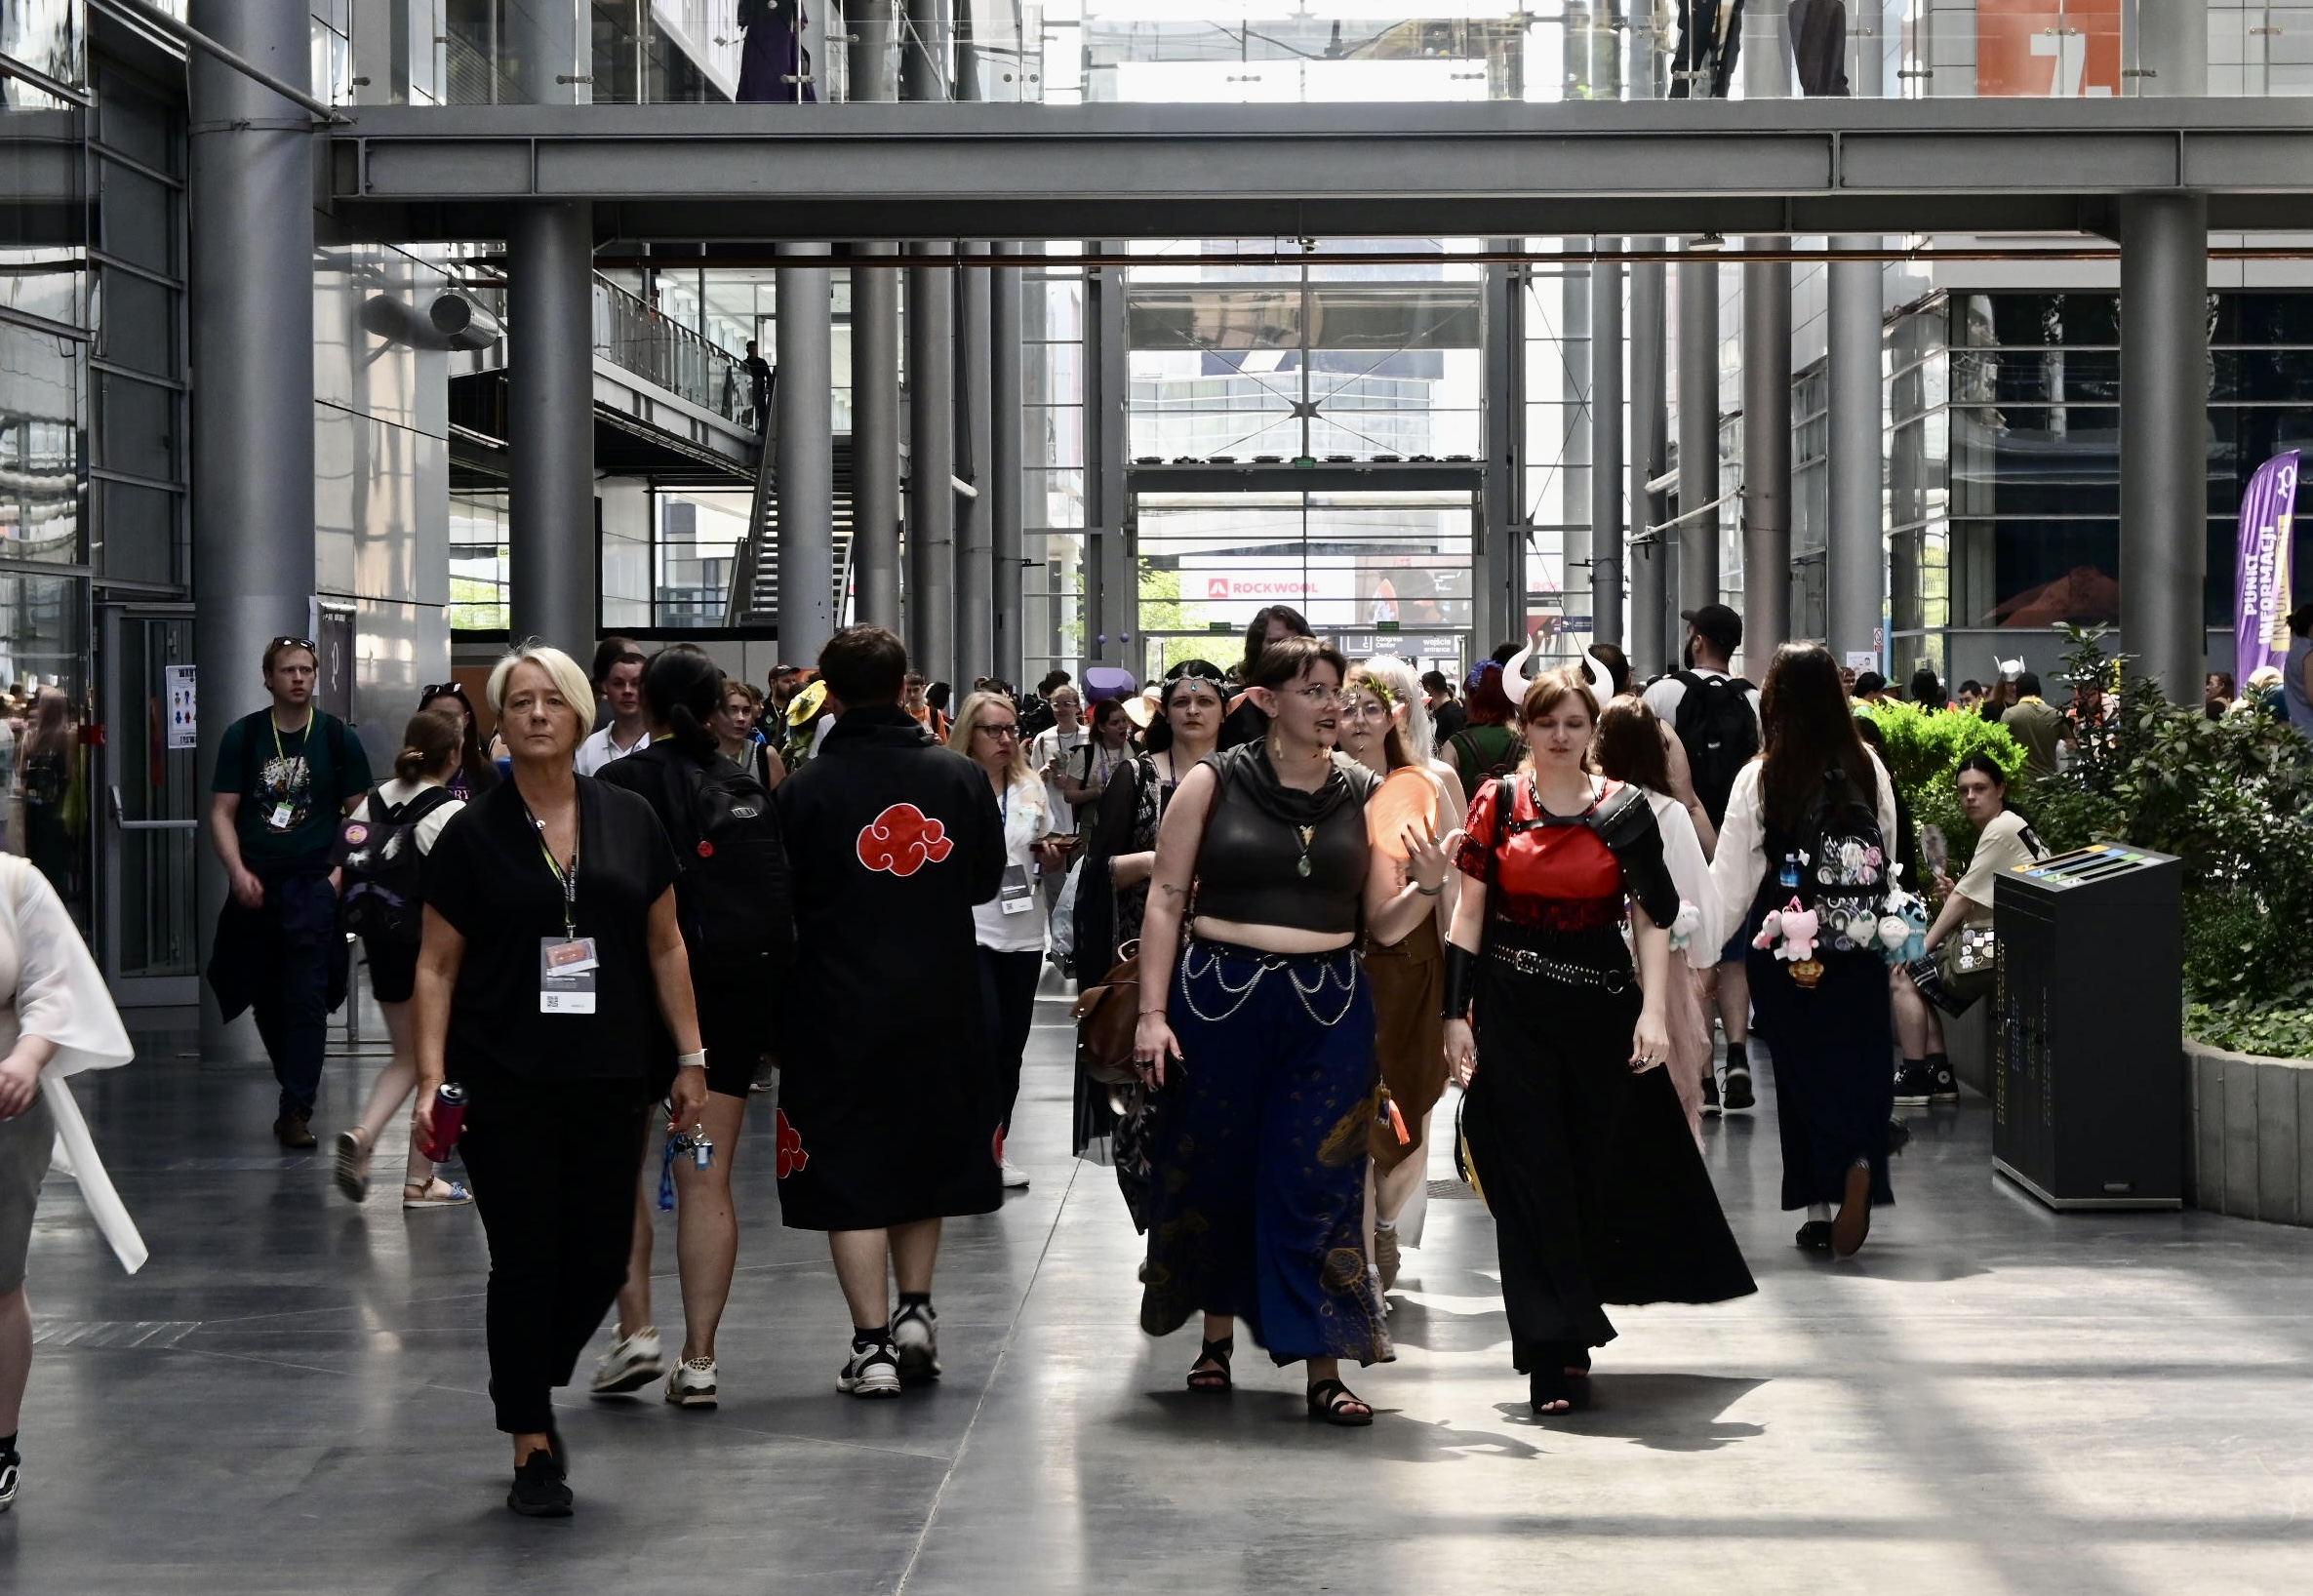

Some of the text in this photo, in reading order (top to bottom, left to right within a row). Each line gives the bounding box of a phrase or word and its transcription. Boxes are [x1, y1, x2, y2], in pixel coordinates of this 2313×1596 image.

[1233, 582, 1319, 593] ROCKWOOL
[2245, 553, 2258, 616] PUNKT
[2258, 526, 2277, 644] INFORMACJI
[1423, 638, 1451, 647] wejście
